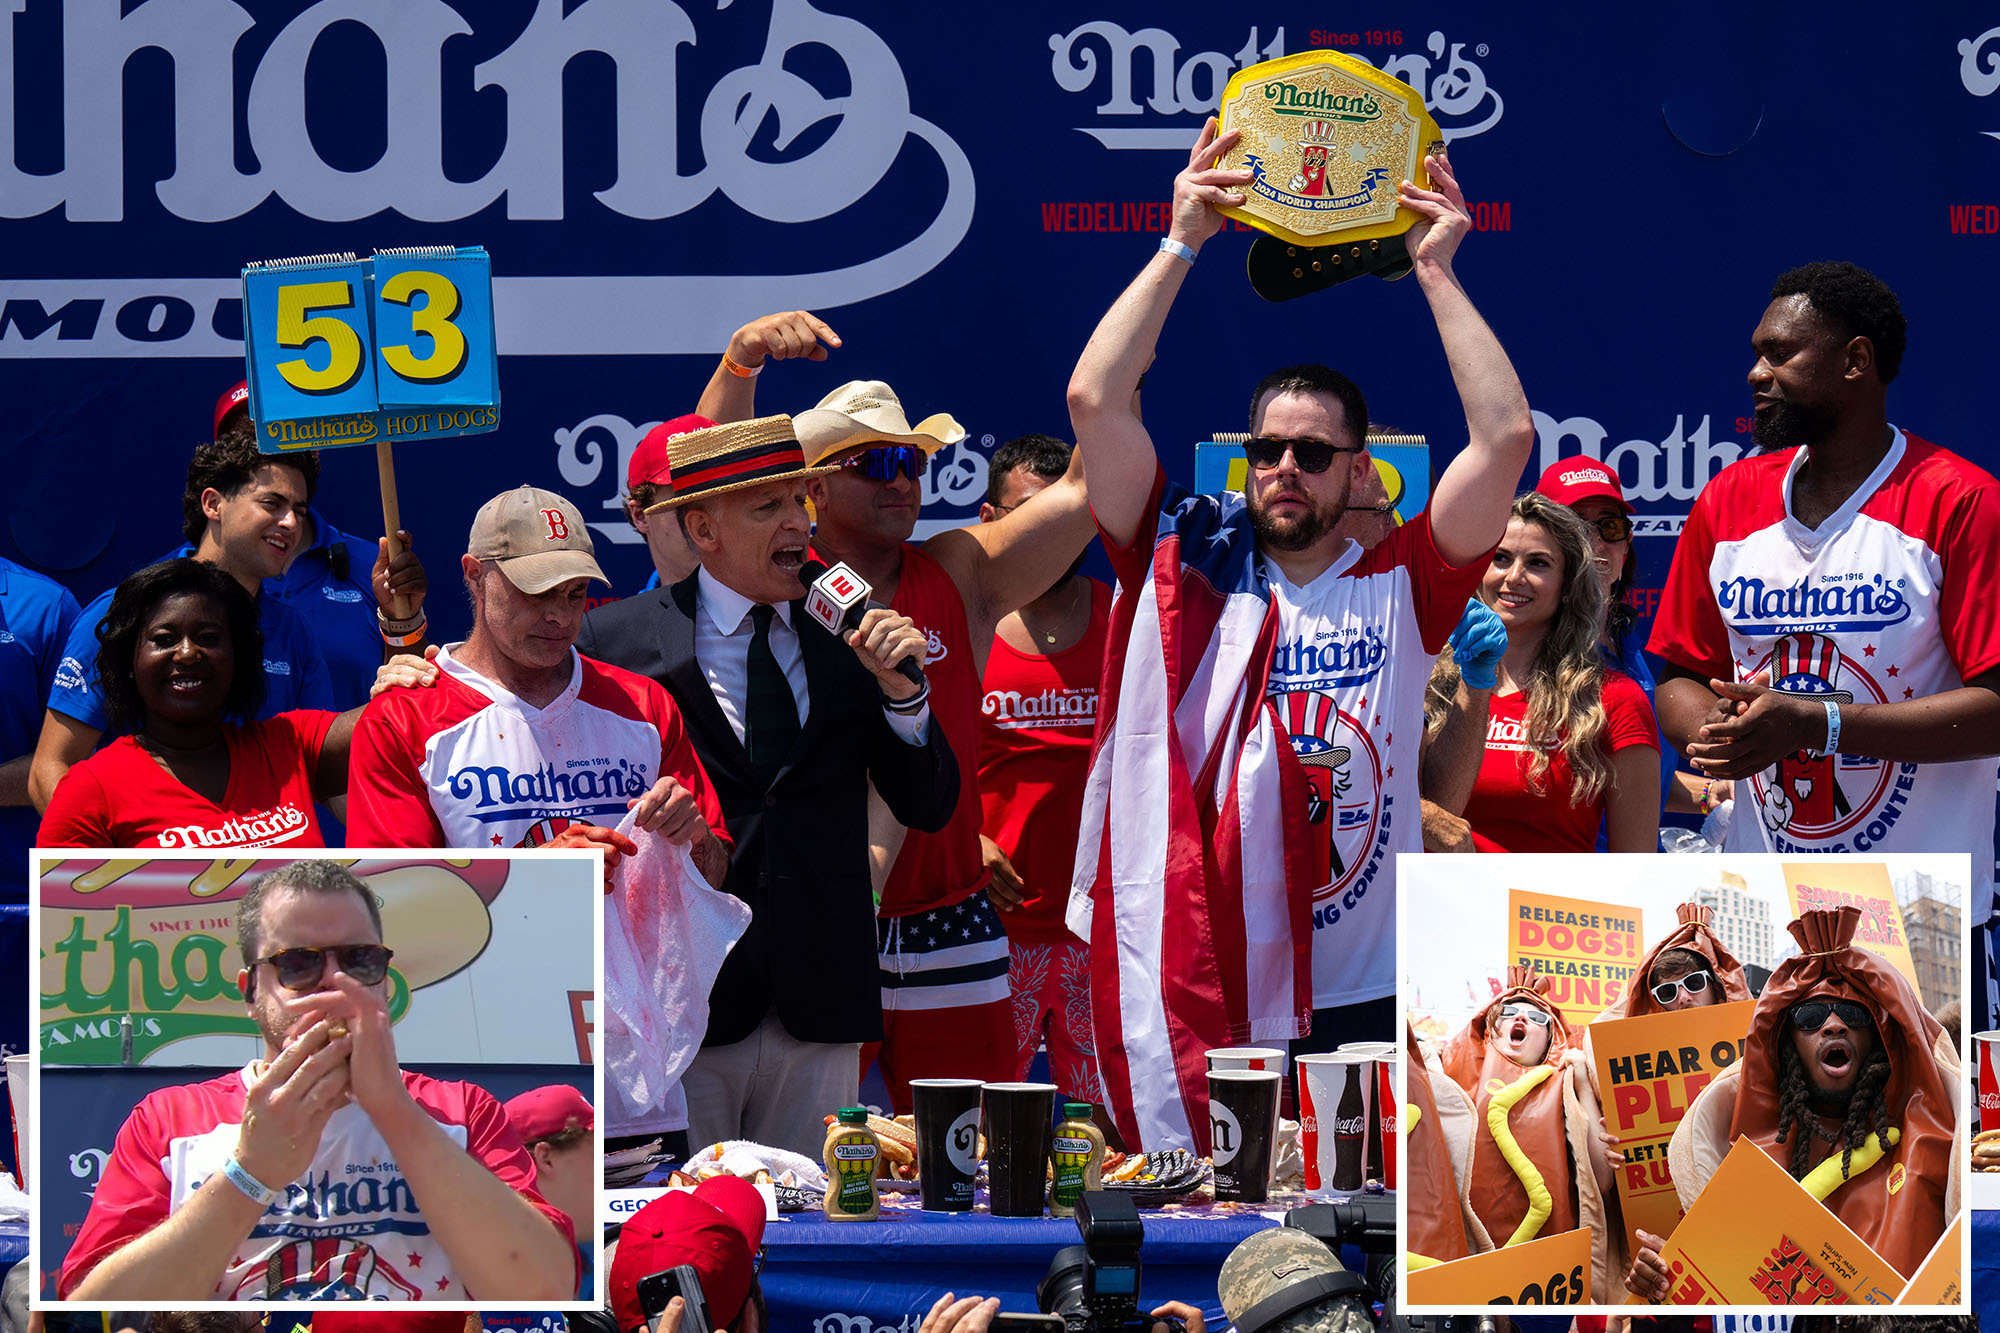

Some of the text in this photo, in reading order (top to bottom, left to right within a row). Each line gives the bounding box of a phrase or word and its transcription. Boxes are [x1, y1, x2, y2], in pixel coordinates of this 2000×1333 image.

[1310, 29, 1403, 46] Since 1916
[1264, 82, 1380, 116] Nathan's
[1254, 181, 1370, 209] 2024 WORLD CHAMPION
[267, 407, 498, 442] Nathan's HOT DOGS
[540, 509, 569, 541] B
[1821, 573, 1864, 583] Since 1916
[1718, 573, 1904, 620] Nathan's
[1315, 627, 1358, 641] Since 1916
[1774, 623, 1838, 634] FAMOUS
[1268, 680, 1337, 692] FAMOUS
[565, 757, 610, 769] Since 1916
[447, 758, 648, 808] Nathan's
[530, 807, 596, 817] FAMOUS
[157, 804, 305, 849] Nathan's
[1342, 793, 1394, 911] CONTEST
[1795, 883, 1895, 915] SAUSAGE
[1519, 905, 1636, 933] RELEASE THE
[1519, 920, 1636, 958] DOGS!
[1608, 1046, 1704, 1085] HEAR
[1623, 1144, 1655, 1164] LET
[345, 1163, 375, 1175] Since
[843, 1184, 870, 1195] MUSTARD
[1058, 1178, 1083, 1187] MUSTARD
[609, 1199, 656, 1212] GEO
[286, 1222, 377, 1237] FAMOUS
[1829, 1261, 1852, 1281] JULY
